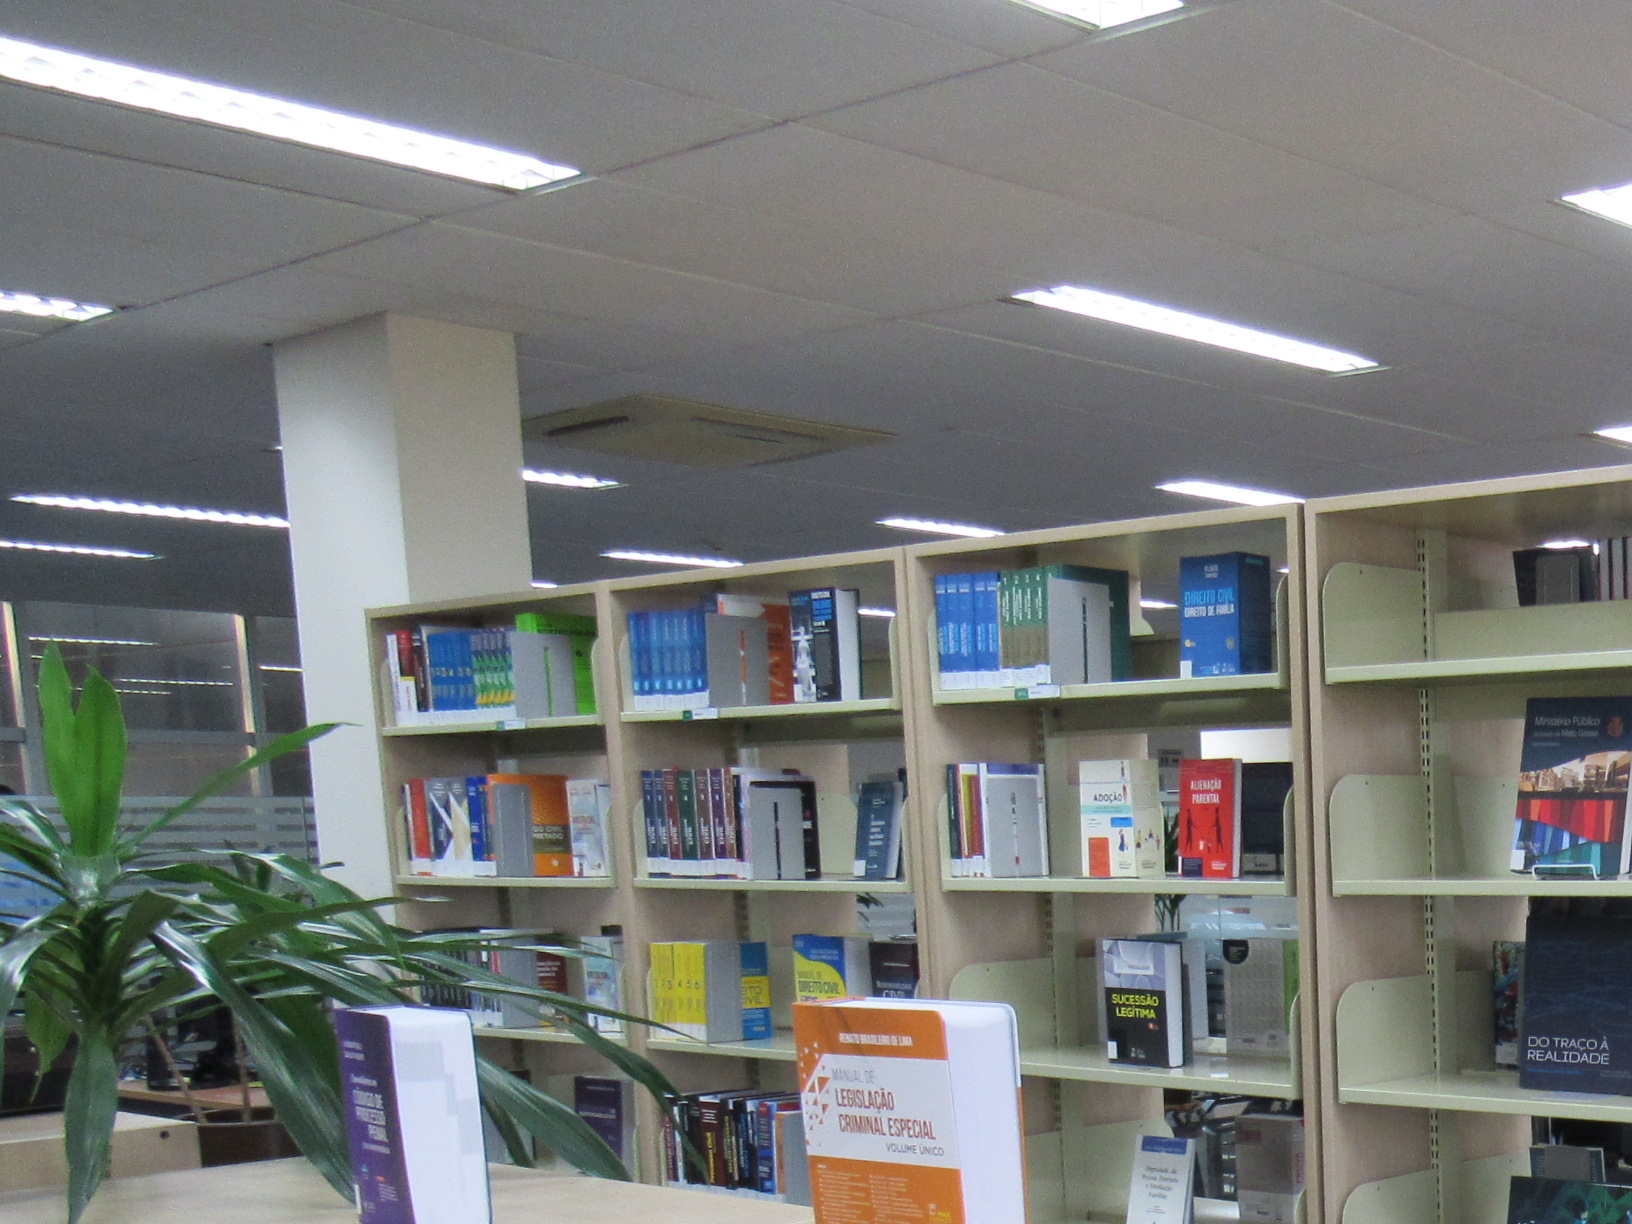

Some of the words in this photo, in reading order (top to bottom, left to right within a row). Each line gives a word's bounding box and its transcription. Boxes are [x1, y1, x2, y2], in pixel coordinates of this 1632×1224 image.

[1184, 590, 1215, 606] DIREITO
[1217, 587, 1235, 603] CIVIL
[1534, 716, 1571, 727] Ministério
[1572, 716, 1601, 727] Público
[1577, 729, 1599, 738] Grosso
[1190, 778, 1222, 792] ALIENAÇÃO
[1093, 791, 1123, 803] ADOÇÃO
[1192, 793, 1220, 805] PARENTAL
[1111, 993, 1160, 1008] SUCESSÃO
[1115, 1005, 1156, 1020] LEGÍTIMA
[1527, 1036, 1550, 1048] DO
[1552, 1037, 1598, 1052] TRAÇO
[1599, 1035, 1609, 1050] À
[1527, 1049, 1610, 1065] REALIDADE
[832, 1068, 863, 1083] MANUAL
[865, 1070, 875, 1084] DE
[835, 1088, 895, 1114] LEGISLAÇÃO
[838, 1114, 887, 1136] CRIMINAL
[888, 1118, 937, 1140] ESPECIAL
[885, 1142, 918, 1154] VOLUME
[919, 1142, 945, 1157] ÚNICO
